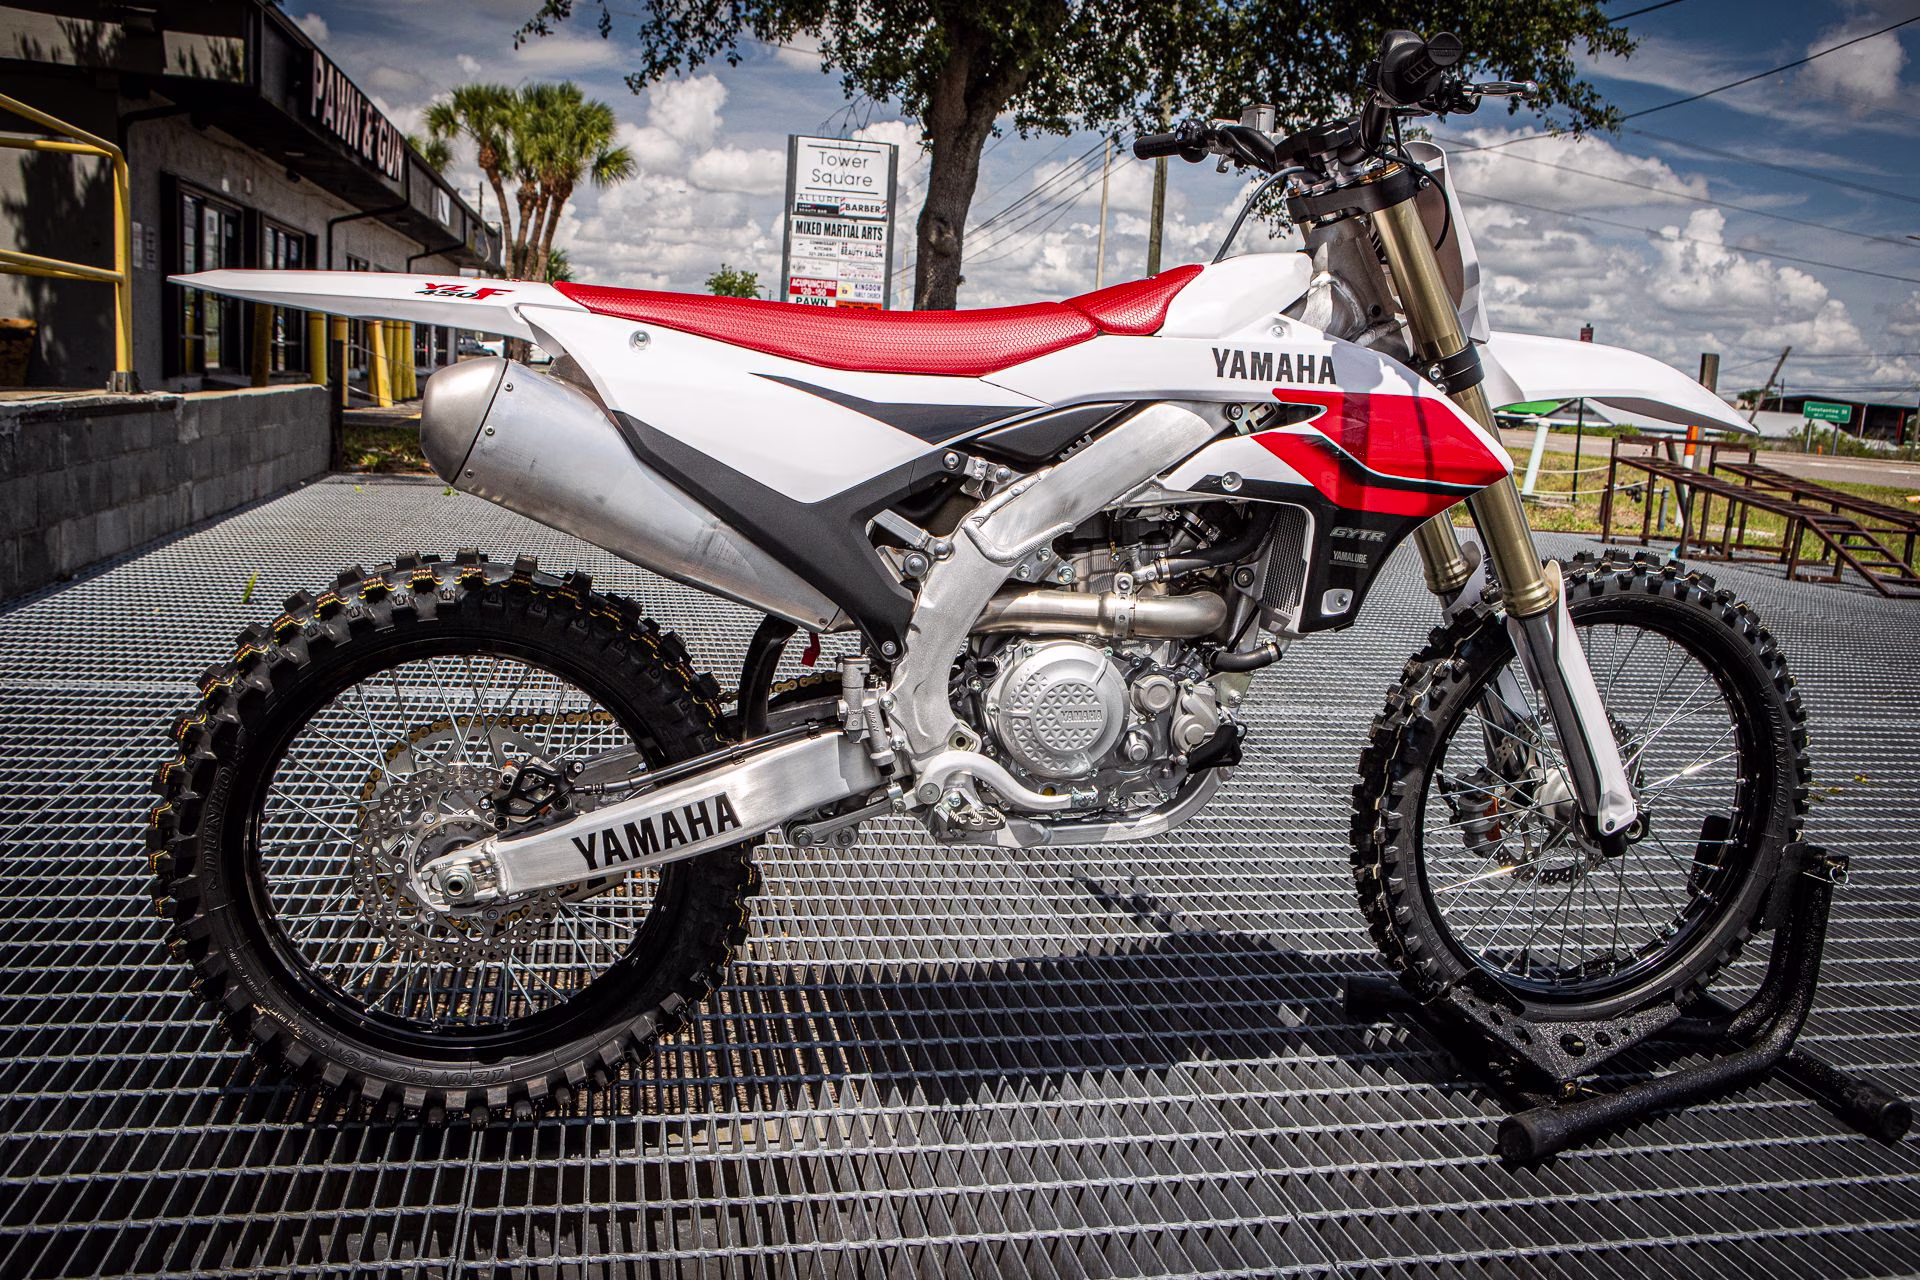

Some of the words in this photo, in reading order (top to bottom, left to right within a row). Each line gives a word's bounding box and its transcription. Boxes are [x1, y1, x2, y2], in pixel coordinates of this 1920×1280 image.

[311, 49, 361, 151] PAWN
[362, 104, 374, 161] &
[377, 117, 404, 182] GUN
[819, 151, 869, 168] Tower
[812, 168, 873, 187] Square
[798, 194, 839, 203] ALLURE
[845, 203, 881, 213] BARBER
[796, 220, 822, 236] MIXED
[823, 222, 859, 239] MARTIAL
[861, 226, 883, 241] ARTS
[841, 247, 863, 256] BEAUTY
[791, 278, 836, 290] ACUPUNCTURE
[855, 283, 881, 292] KINGDOM
[796, 297, 828, 307] PAWN
[1212, 347, 1337, 385] YAMAHA
[1329, 526, 1387, 543] GYTR
[1333, 550, 1368, 564] YAMALUBE
[1060, 709, 1103, 723] YAMAHA
[571, 791, 743, 871] YAMAHA
